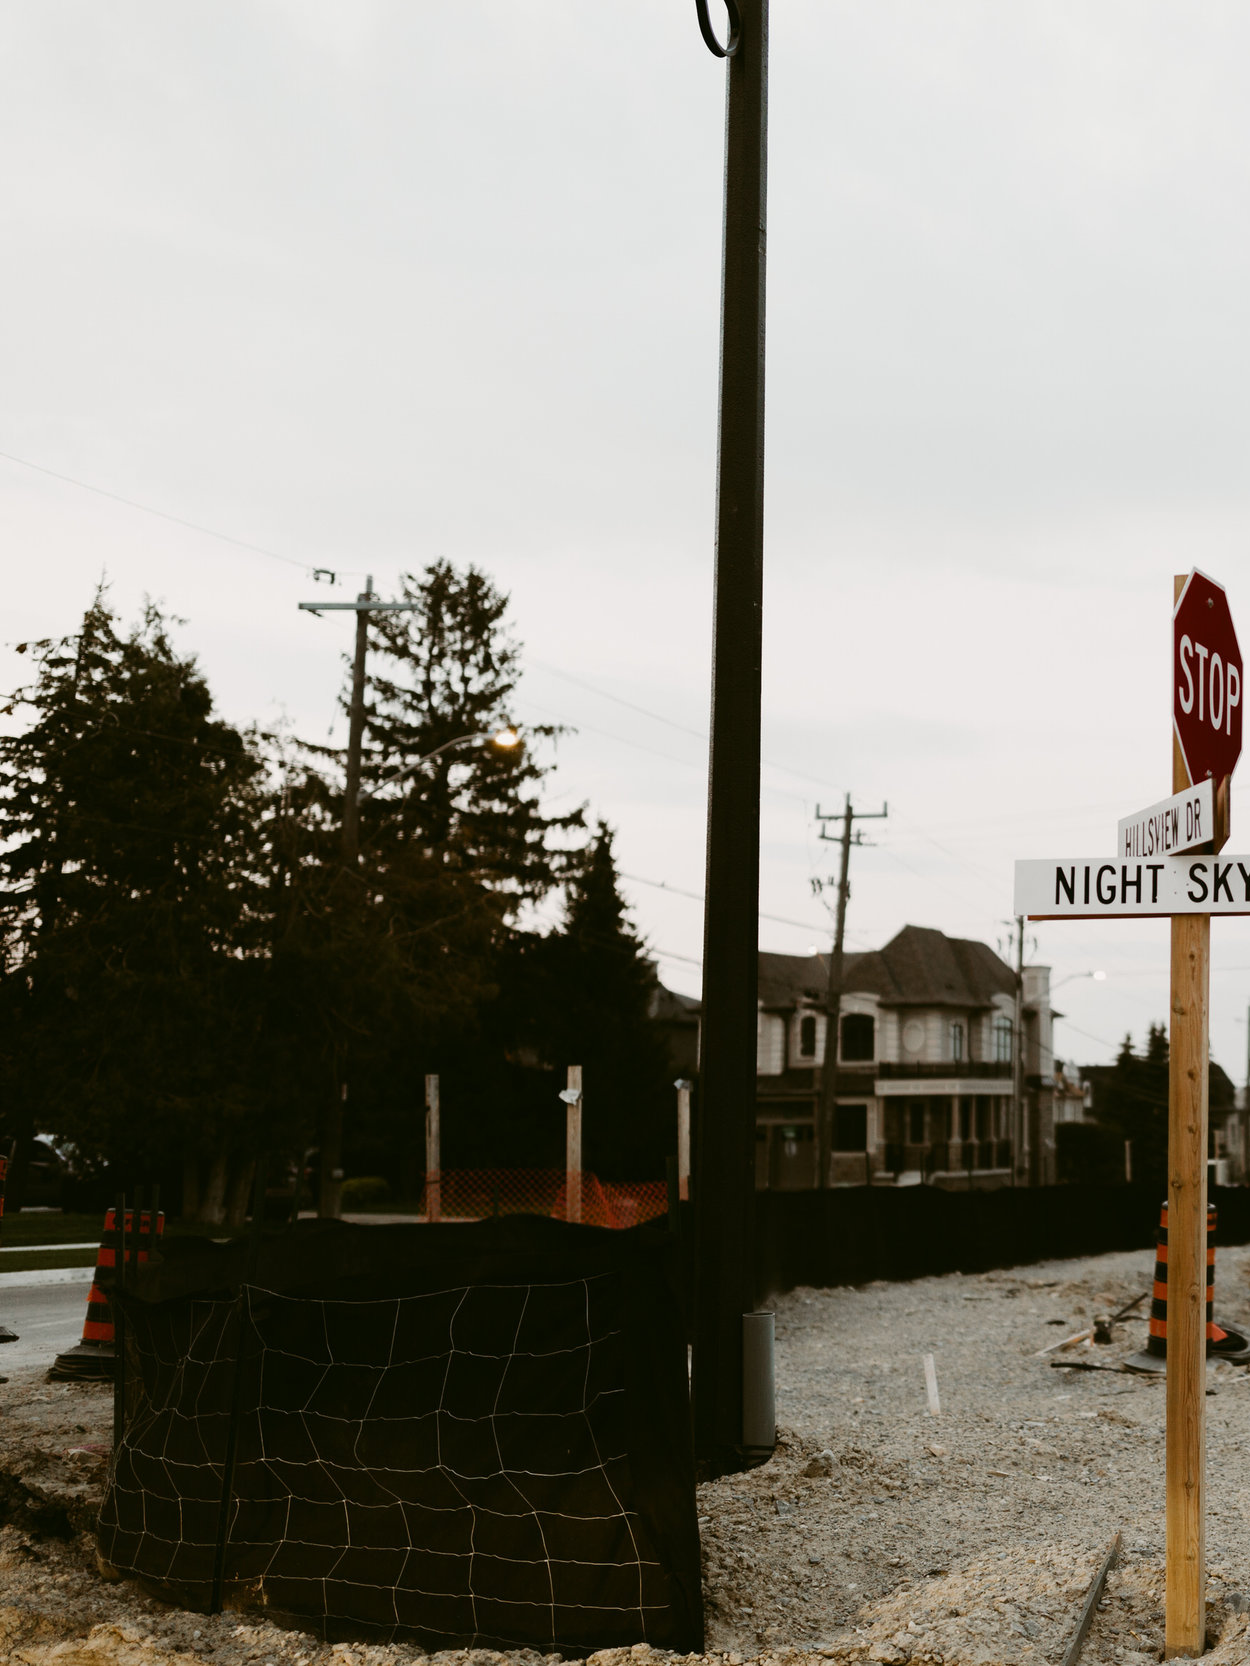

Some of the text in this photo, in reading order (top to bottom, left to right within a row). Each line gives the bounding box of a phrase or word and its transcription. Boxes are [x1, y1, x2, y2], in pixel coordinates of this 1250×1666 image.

[1179, 634, 1240, 736] STOP
[1125, 798, 1202, 857] HILLSVIEW DR
[1055, 864, 1165, 905] NIGHT
